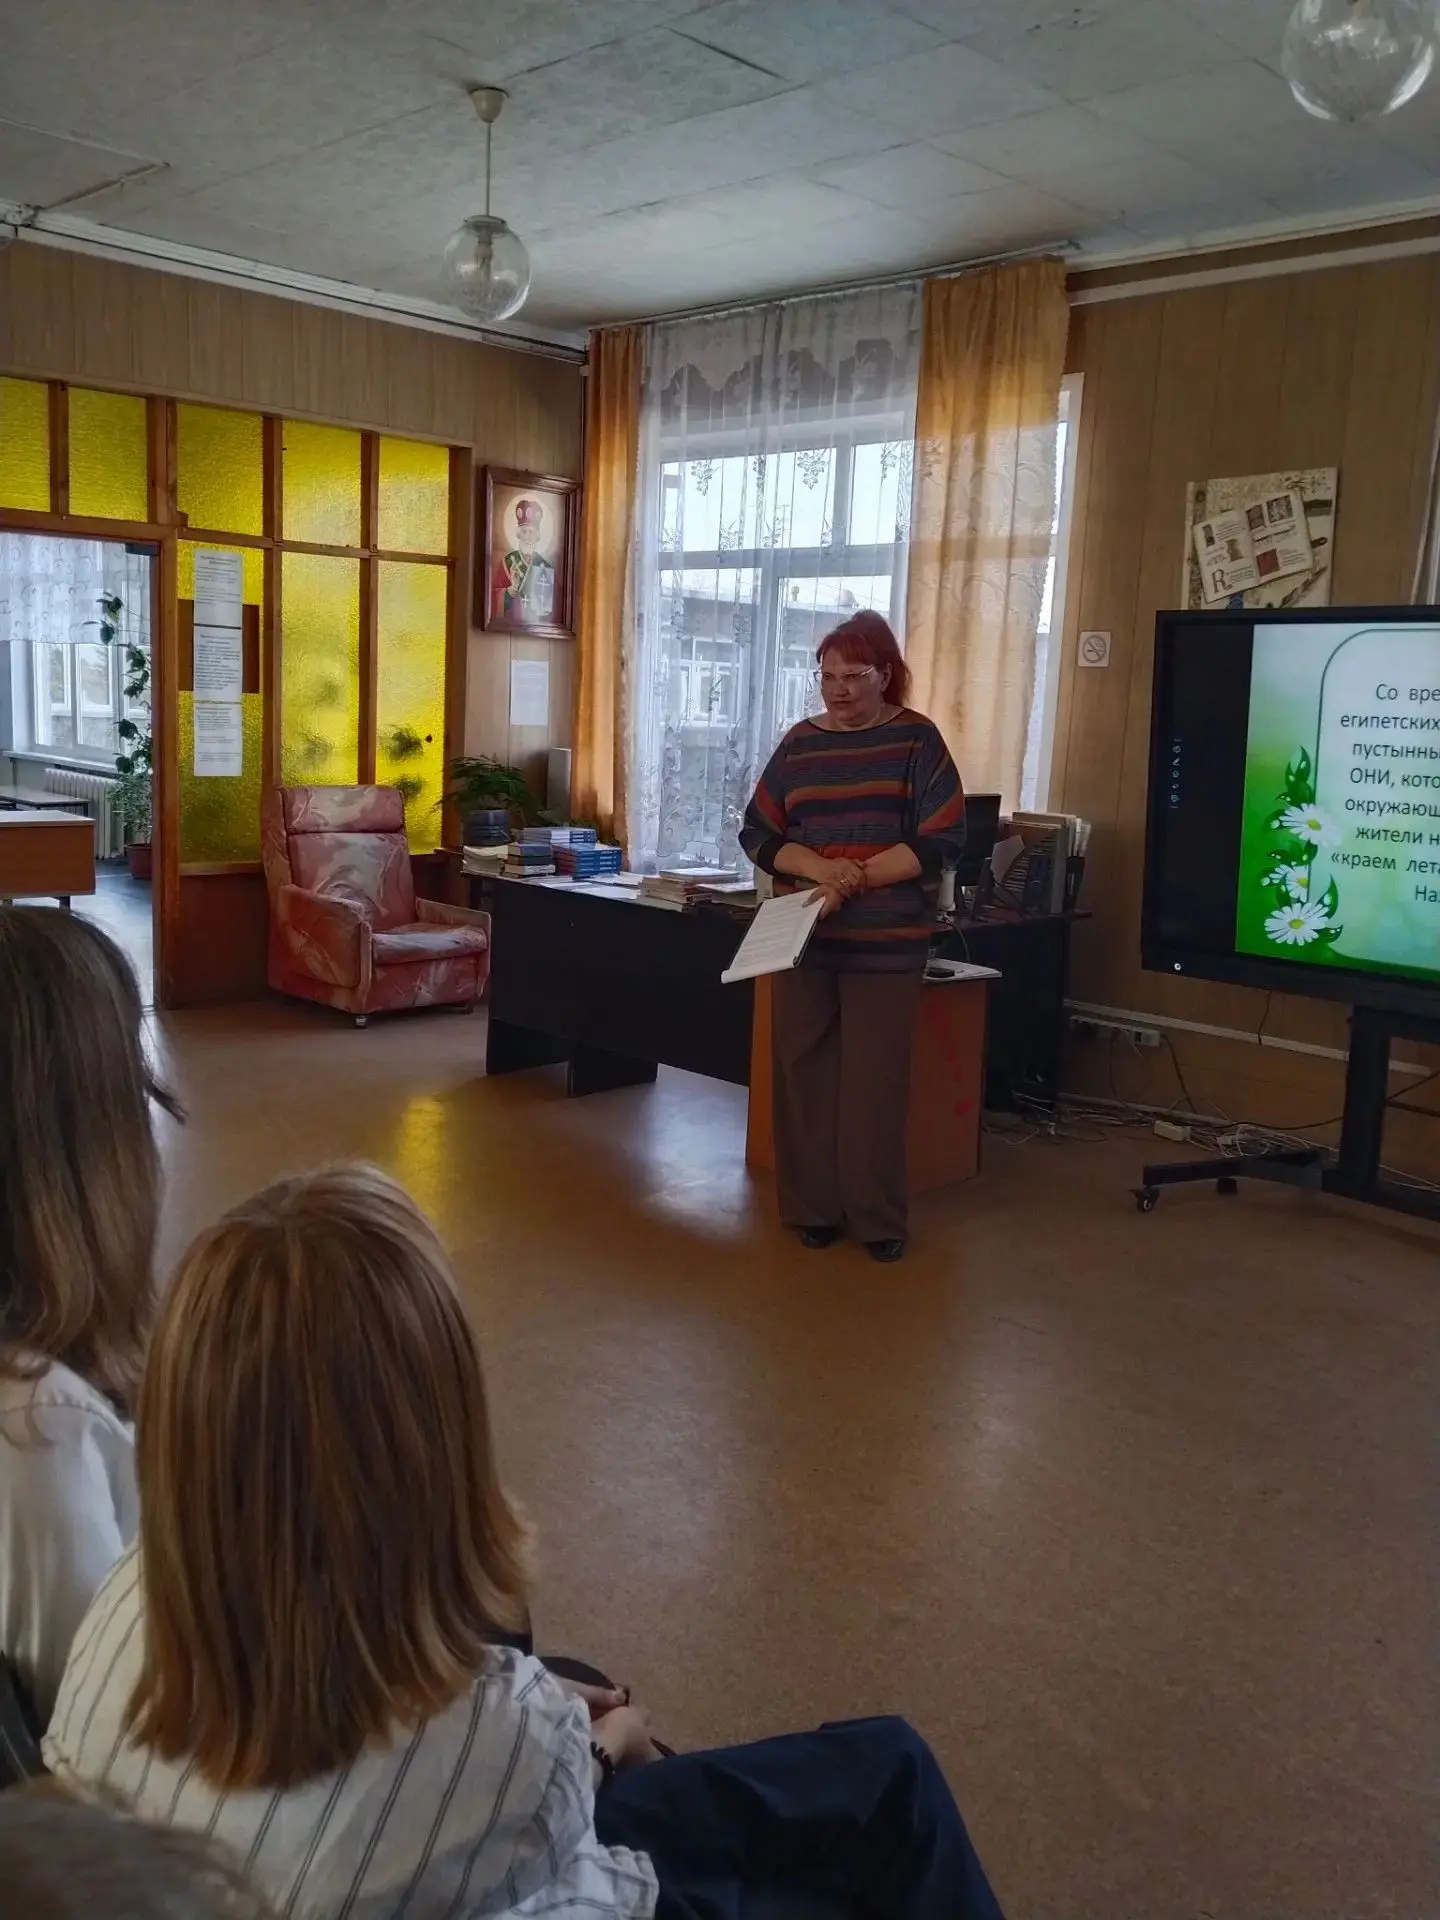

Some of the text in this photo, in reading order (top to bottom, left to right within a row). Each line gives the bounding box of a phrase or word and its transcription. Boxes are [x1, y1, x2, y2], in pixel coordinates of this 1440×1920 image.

[1376, 684, 1440, 704] Со вре
[1340, 715, 1440, 730] египетских
[1350, 767, 1440, 789] ОНИ, кото
[1356, 827, 1422, 844] жители
[1331, 853, 1440, 874] «краем лет
